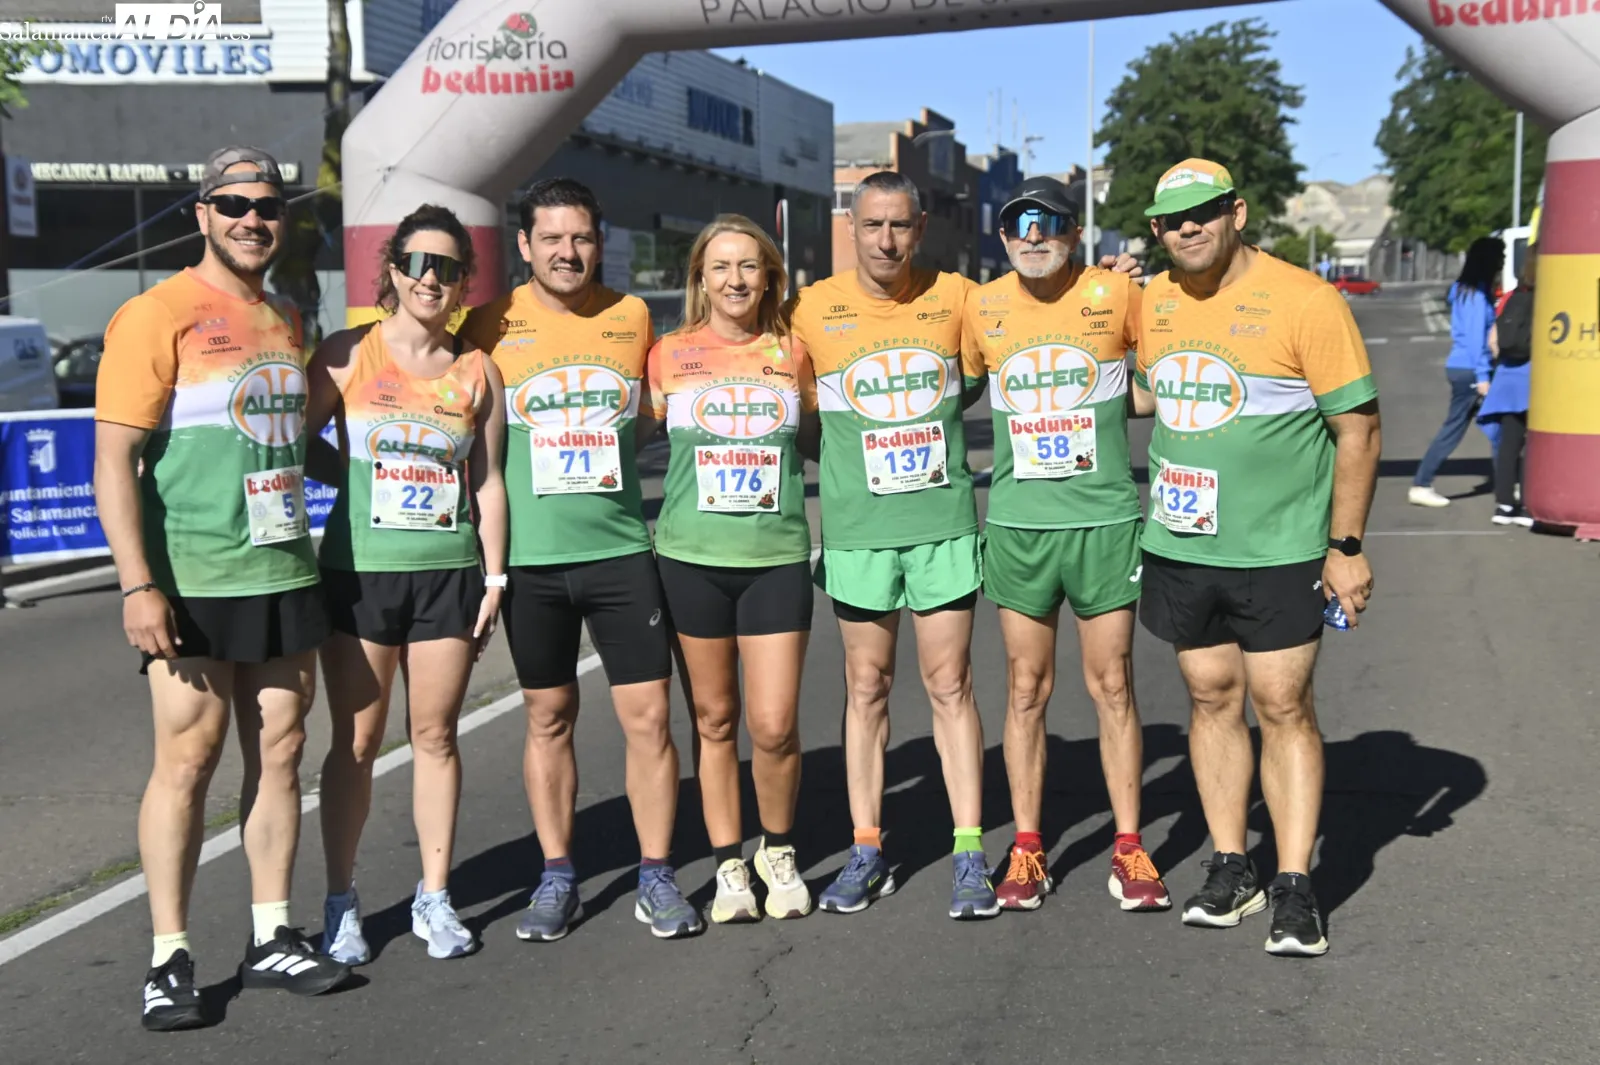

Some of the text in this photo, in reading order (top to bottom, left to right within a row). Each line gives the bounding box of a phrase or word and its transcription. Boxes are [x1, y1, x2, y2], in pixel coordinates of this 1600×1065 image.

[12, 43, 273, 75] OMOVILES
[426, 33, 567, 62] floristería
[421, 64, 575, 94] bedunia
[31, 163, 108, 182] MECANICA
[110, 164, 168, 183] RAPIDA
[837, 337, 949, 370] CLUB DEPORTIVO
[996, 333, 1100, 365] CLUB DEPORTIVO
[1179, 340, 1247, 372] DEPORTIVO
[226, 356, 253, 384] CLUB
[511, 354, 632, 386] CLUB DEPORTIVO
[1005, 366, 1089, 392] ALCER
[693, 375, 785, 395] CLUB DEPORTIVO
[854, 369, 940, 398] ALCER
[1155, 379, 1233, 408] ALCER
[240, 394, 308, 416] ALCER
[525, 389, 622, 414] ALCER
[701, 402, 780, 421] ALCER
[366, 411, 461, 443] CLUB DEPORTIVO
[1010, 415, 1093, 435] bedunia
[375, 438, 450, 460] ALCER
[533, 431, 616, 449] bedunia
[865, 427, 943, 451] bedunia
[1036, 434, 1071, 460] 58
[559, 449, 591, 474] 71
[697, 449, 778, 467] bedunia
[885, 445, 931, 475] 137
[374, 463, 457, 485] bedunia
[715, 468, 762, 493] 176
[282, 492, 296, 519] 5
[400, 484, 434, 510] 22
[1158, 484, 1198, 514] 132
[52, 522, 87, 537] Local
